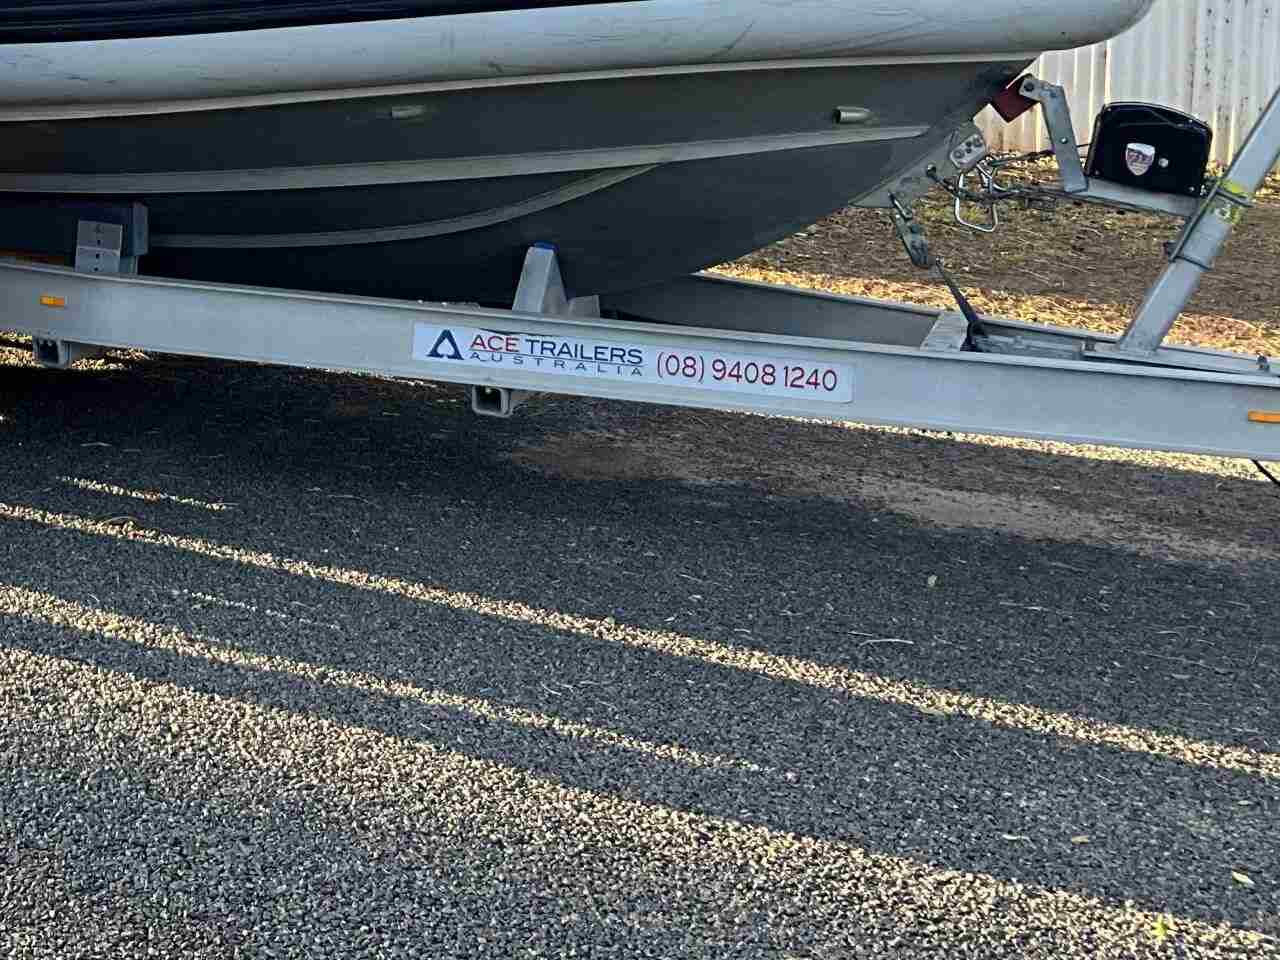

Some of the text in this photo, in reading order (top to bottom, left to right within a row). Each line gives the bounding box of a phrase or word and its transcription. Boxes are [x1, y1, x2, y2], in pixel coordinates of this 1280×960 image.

[469, 334, 644, 366] ACE TRAILERS
[469, 351, 644, 378] AUSTRALIA
[655, 351, 838, 393] (08) 9408 1240
